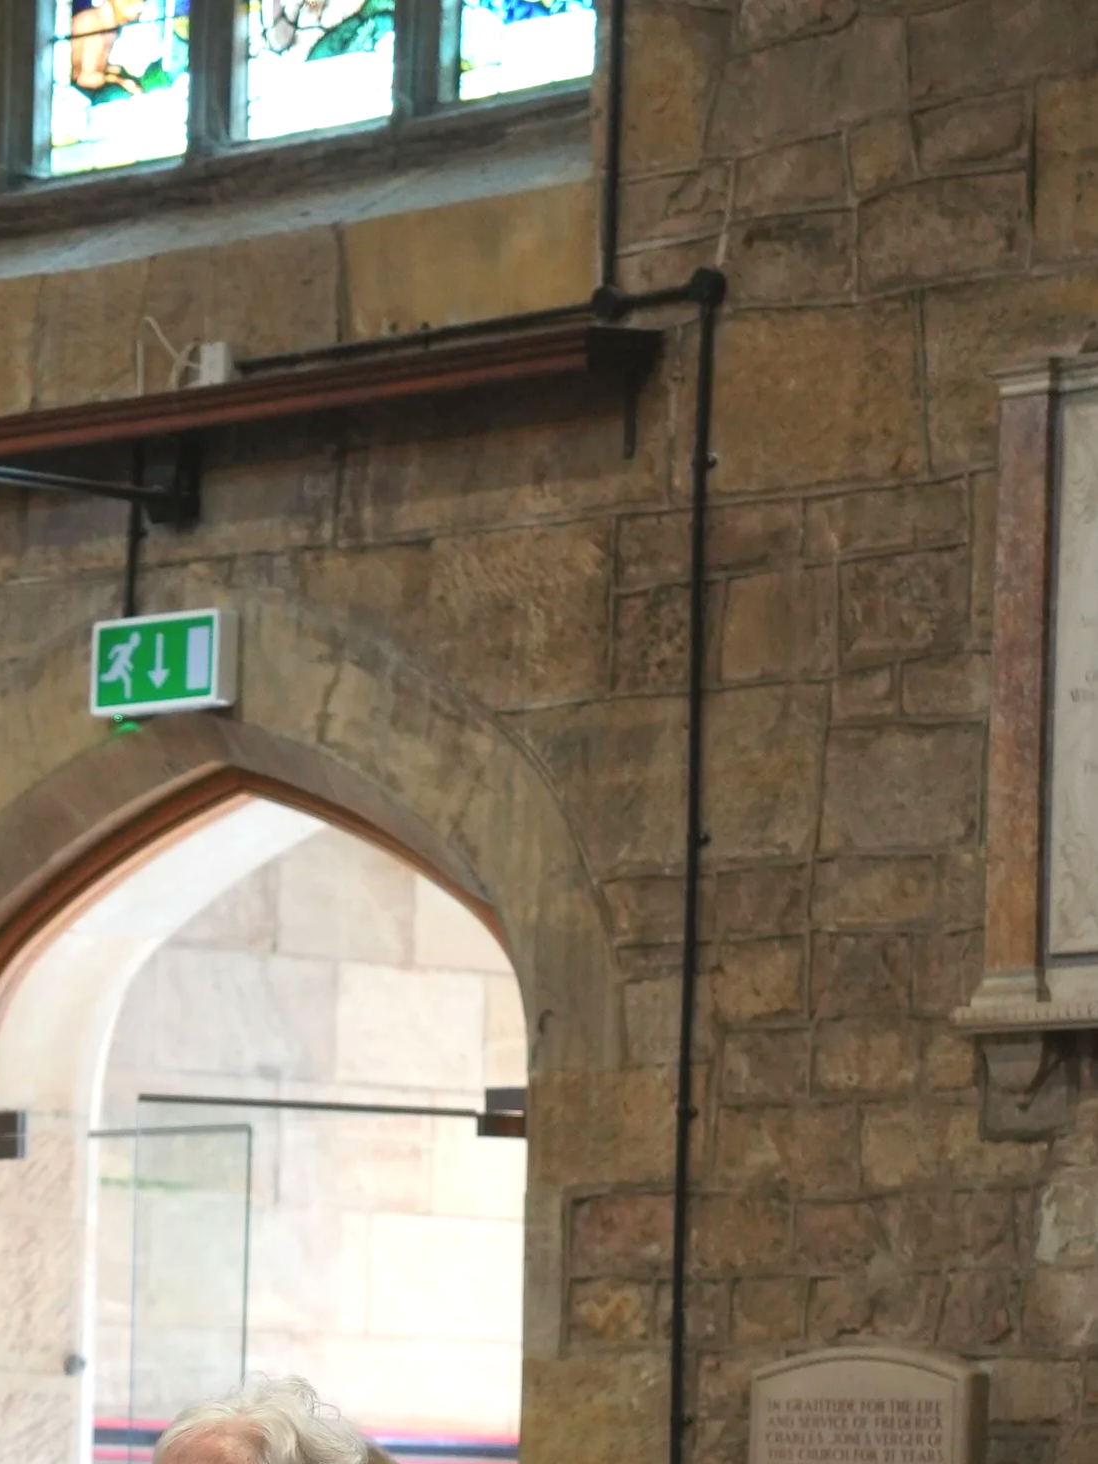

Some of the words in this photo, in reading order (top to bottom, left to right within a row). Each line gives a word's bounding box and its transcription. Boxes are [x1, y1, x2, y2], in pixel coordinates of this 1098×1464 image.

[787, 1399, 854, 1411] GRATITUDE
[861, 1399, 885, 1411] FOR
[890, 1399, 910, 1411] THE
[917, 1399, 942, 1411] LIFE
[767, 1415, 794, 1428] AND
[799, 1415, 847, 1428] SERVICE
[853, 1415, 867, 1428] OF
[875, 1415, 942, 1428] FREDERICK
[765, 1432, 823, 1445] CHARLES
[876, 1432, 923, 1445] VERGER
[928, 1432, 942, 1445] OF
[769, 1448, 793, 1461] THIS
[798, 1448, 848, 1461] CHURCH
[854, 1448, 877, 1461] FOR
